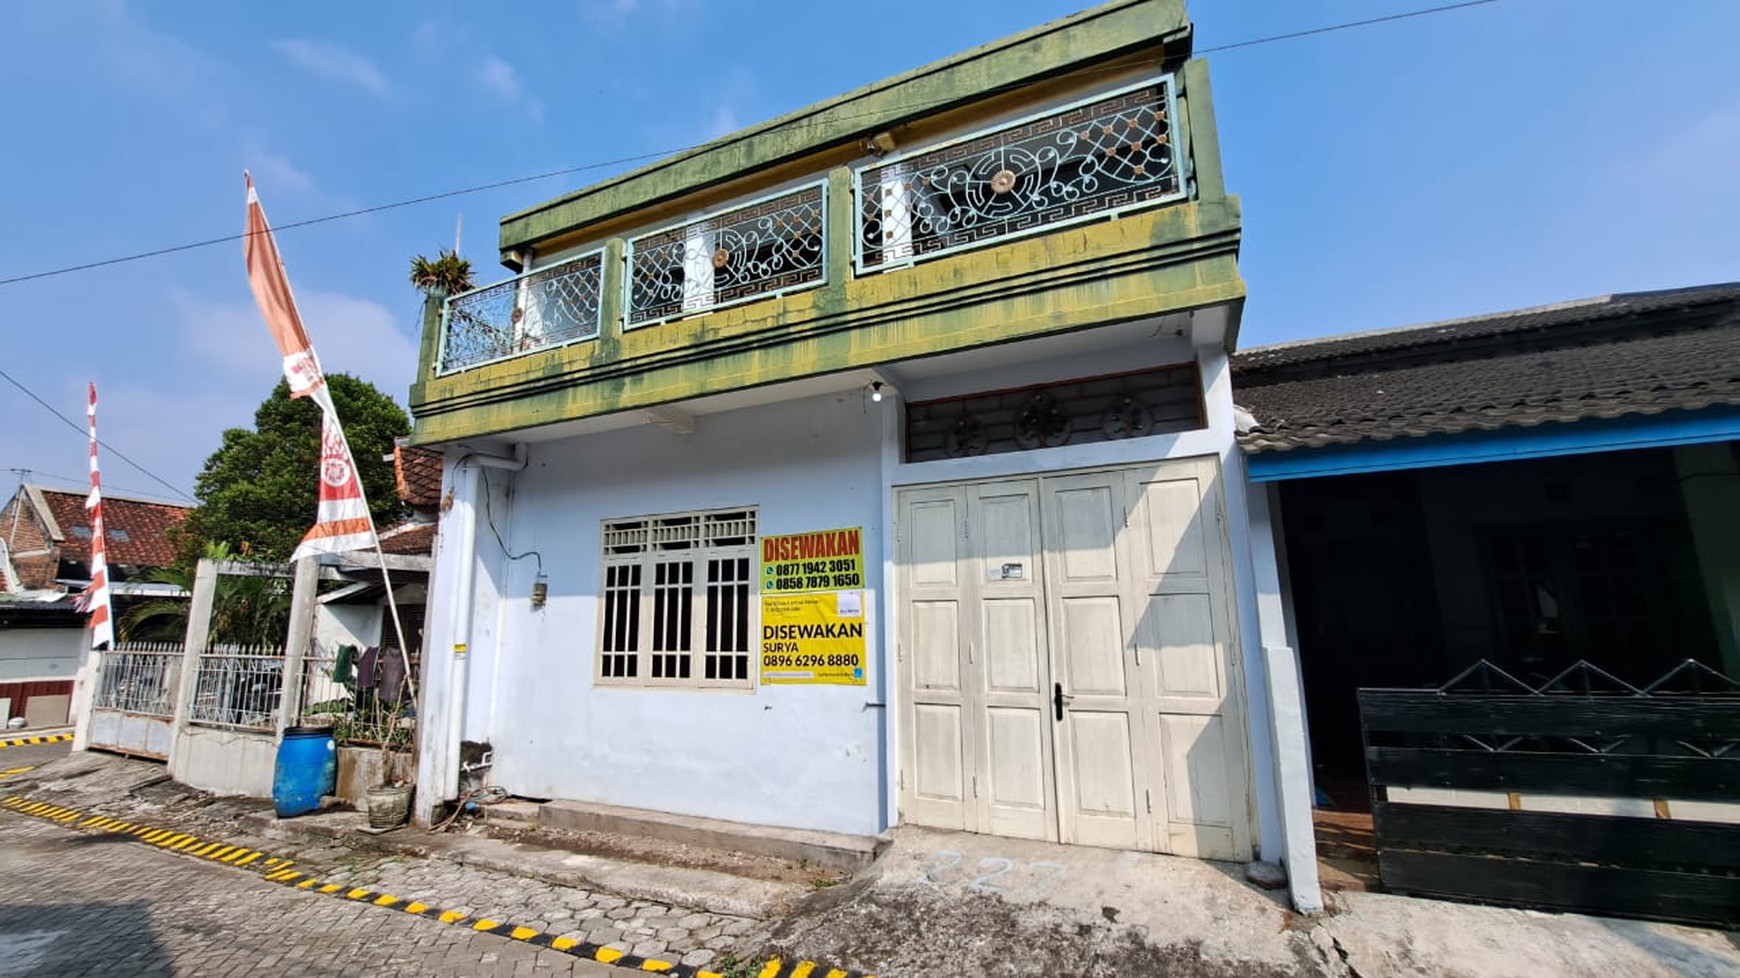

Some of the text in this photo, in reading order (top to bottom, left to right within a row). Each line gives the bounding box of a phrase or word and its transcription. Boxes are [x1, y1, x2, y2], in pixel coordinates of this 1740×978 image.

[764, 530, 860, 562] DISEWAKAN
[776, 559, 855, 576] 0877 1942 3051
[776, 573, 860, 590] 0858 7879 1650
[763, 622, 862, 640] DISEWAKAN
[763, 642, 799, 653] SURYA
[763, 654, 859, 666] 0896 6296 8880
